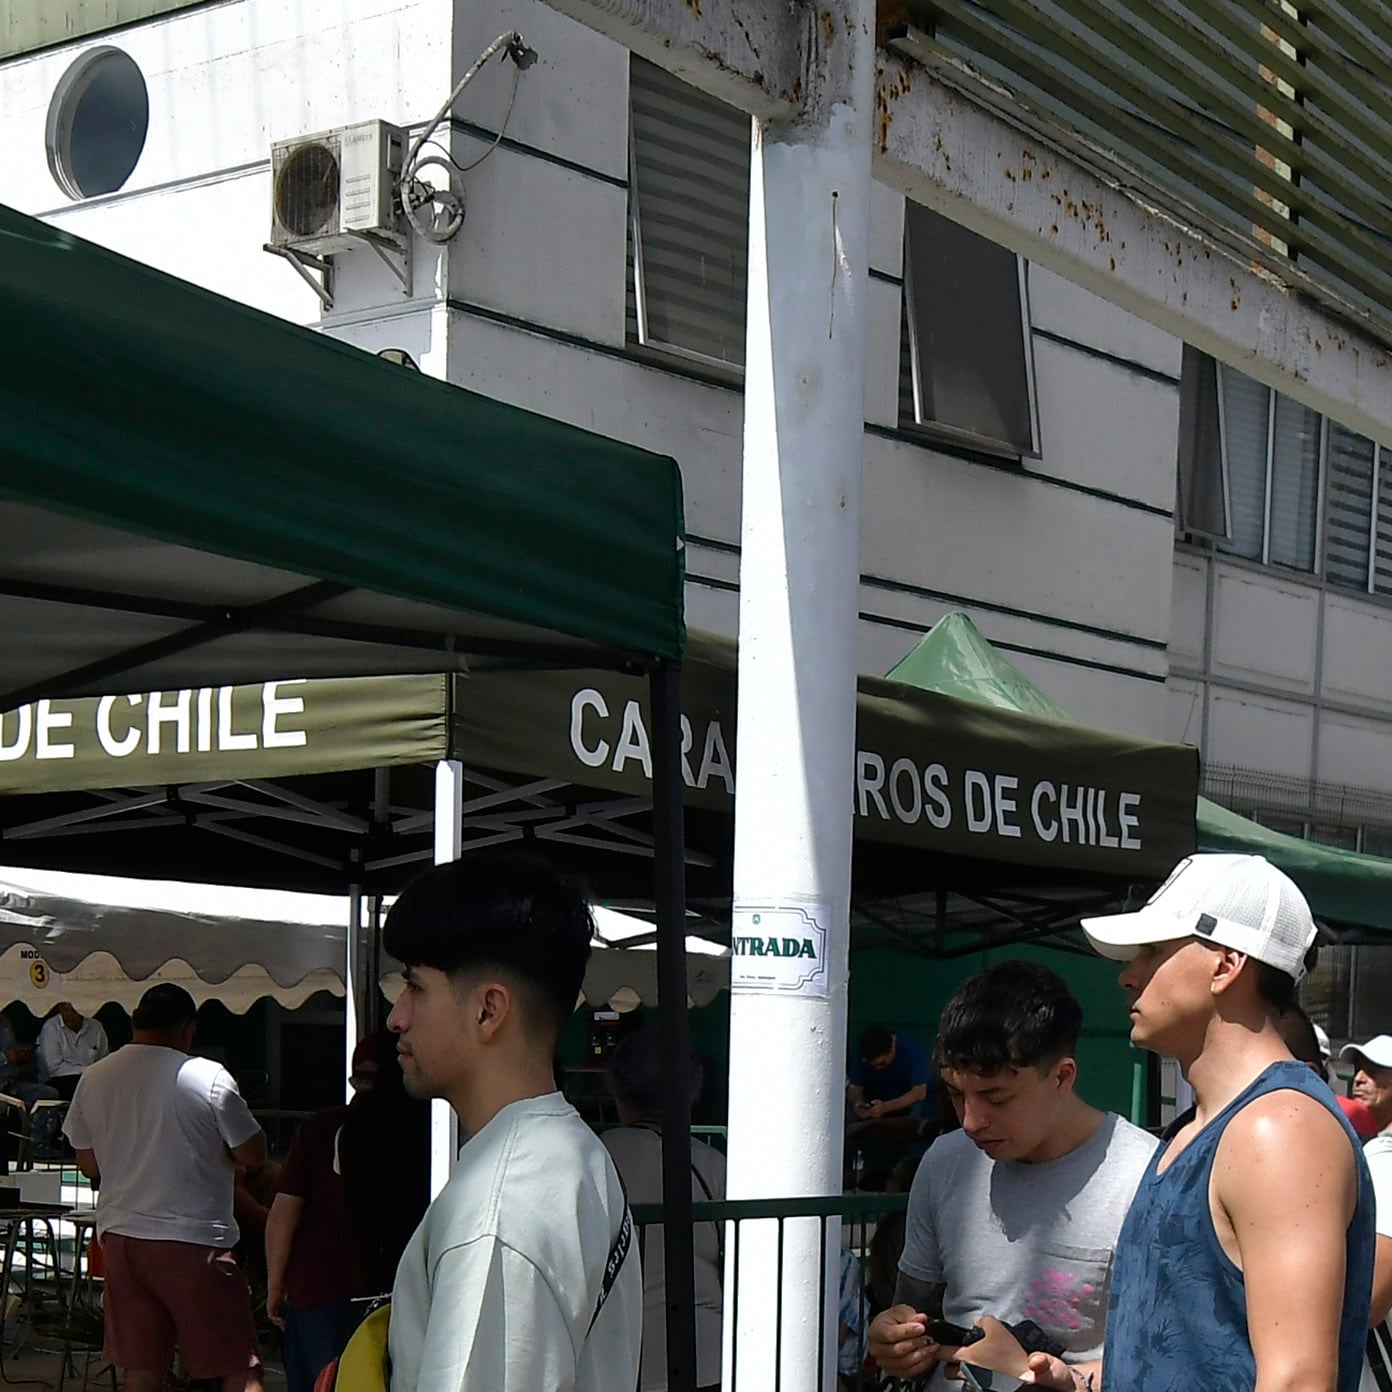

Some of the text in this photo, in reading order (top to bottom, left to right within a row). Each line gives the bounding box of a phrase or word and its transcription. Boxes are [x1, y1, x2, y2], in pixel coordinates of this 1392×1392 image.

[96, 678, 307, 758] CHILE
[964, 769, 1022, 838] DE
[1030, 780, 1142, 850] CHILE
[34, 964, 45, 982] 3
[732, 935, 818, 960] NTRADA
